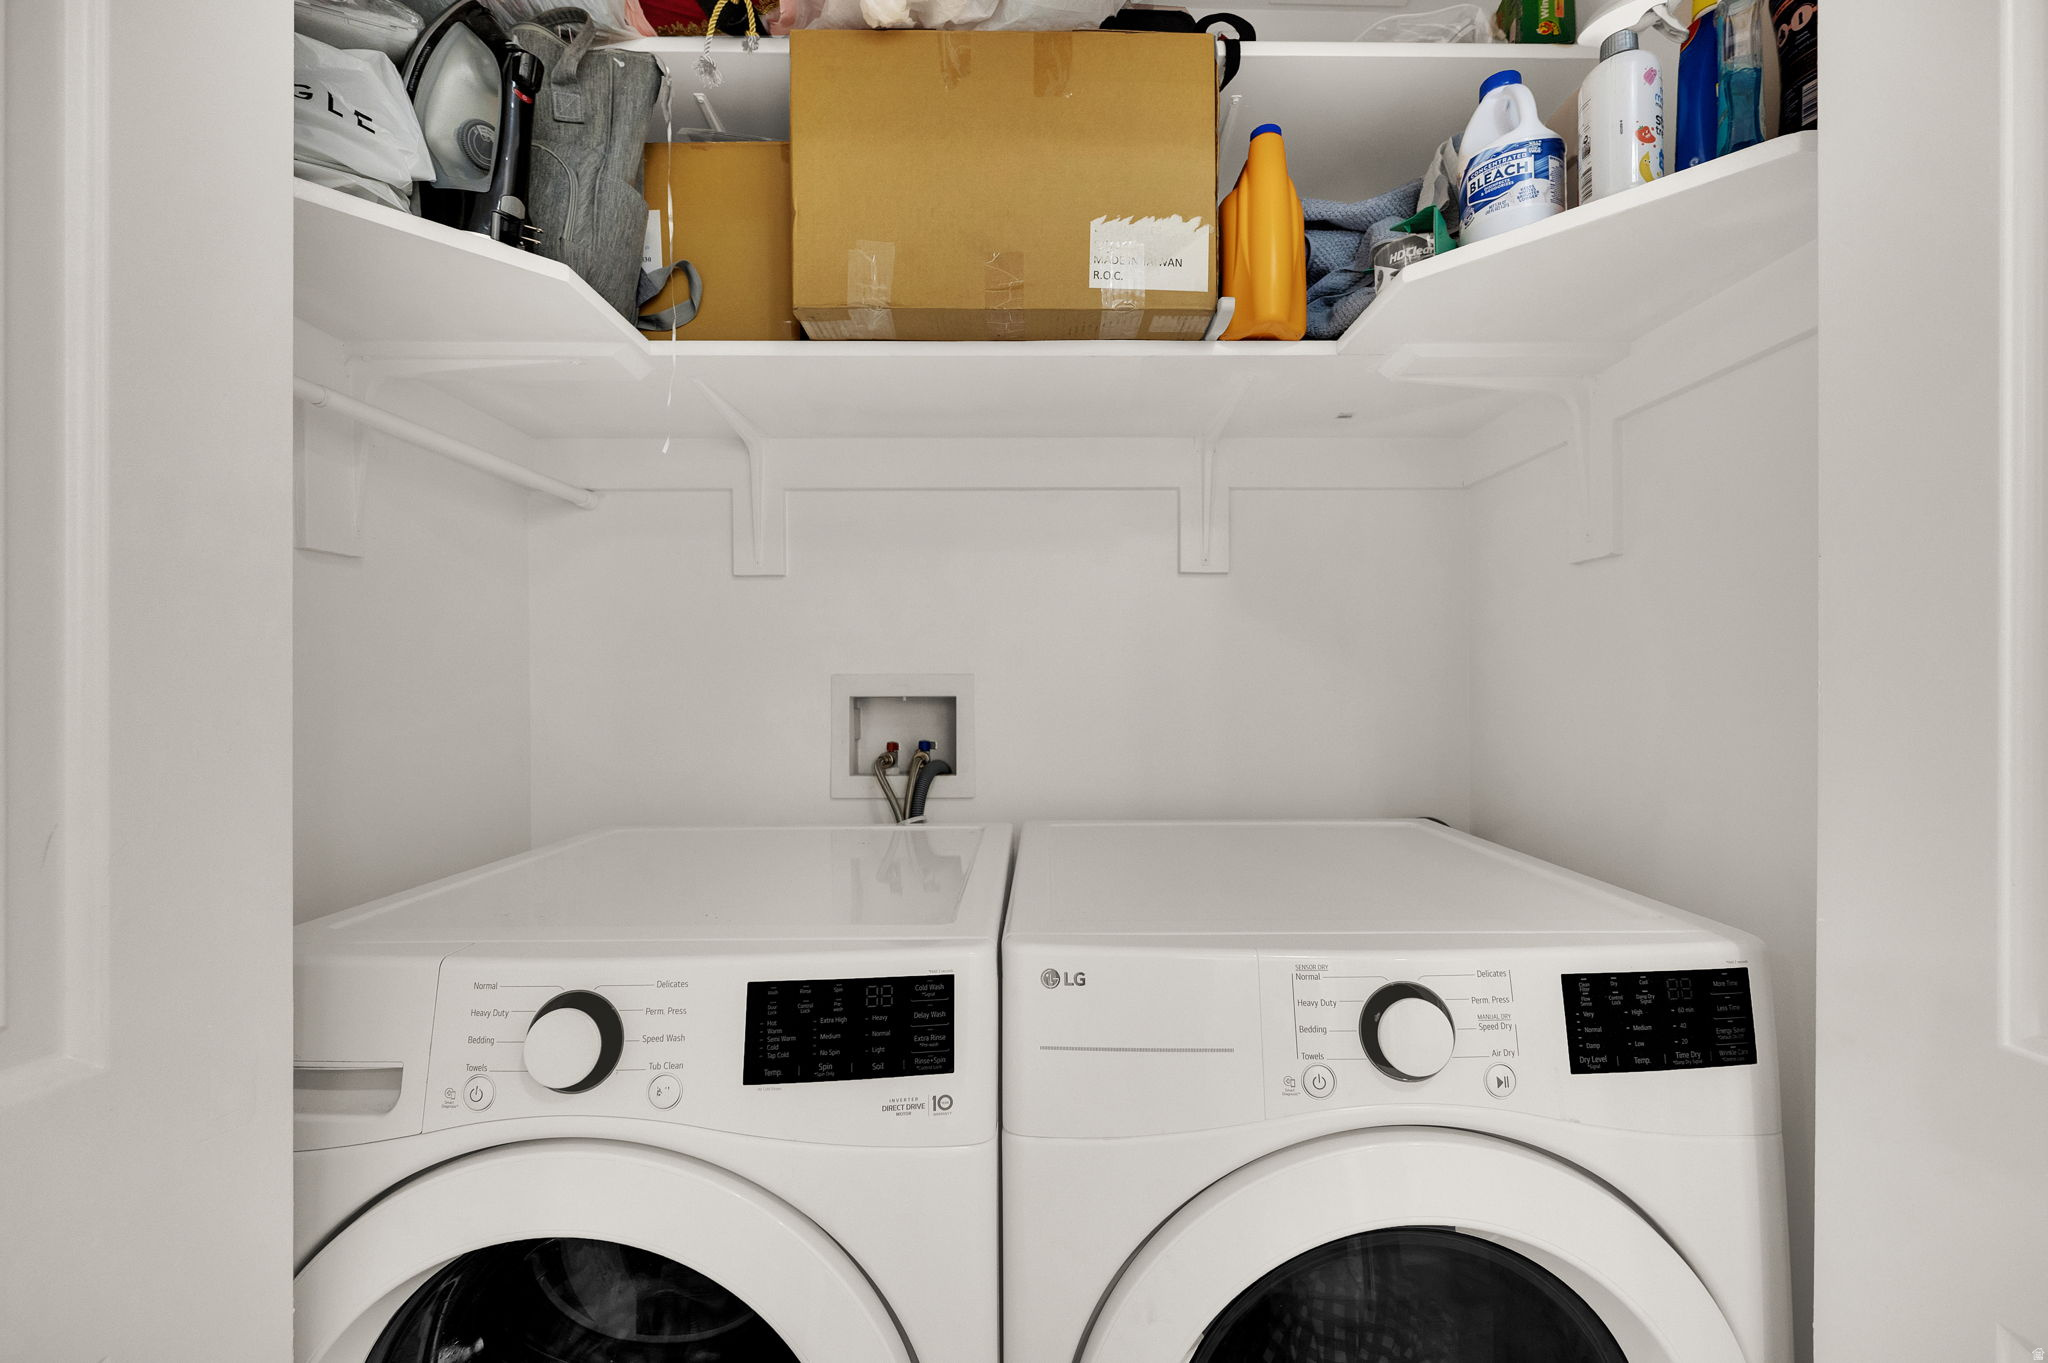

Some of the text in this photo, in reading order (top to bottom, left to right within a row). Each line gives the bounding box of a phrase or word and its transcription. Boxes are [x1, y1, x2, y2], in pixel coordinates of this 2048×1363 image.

[1470, 152, 1527, 179] CONCENTRATED
[1469, 161, 1529, 195] BLEACH
[1093, 271, 1123, 281] R.O.C.
[1476, 970, 1507, 978] Delicates
[1063, 971, 1086, 987] LG
[473, 982, 498, 990] Normal
[656, 980, 689, 989] Delicates
[1297, 999, 1337, 1008] Heavy Duty
[1491, 996, 1510, 1004] Press
[470, 1009, 509, 1019] Heavy Duty
[645, 1007, 687, 1016] Perm. Press
[913, 1012, 930, 1020] Delay
[1299, 1026, 1327, 1035] Bedding
[1478, 1022, 1512, 1032] Speed Dry
[467, 1036, 495, 1046] Bedding
[642, 1034, 686, 1044] Speed Wash
[1301, 1052, 1325, 1060] Towels
[1491, 1049, 1515, 1058] Air Dry
[1579, 1056, 1591, 1064] Dry
[466, 1064, 488, 1072] Towels
[649, 1061, 684, 1070] Tub Clean
[818, 1063, 833, 1072] Spin
[881, 1103, 926, 1112] DIRECT DRIVE
